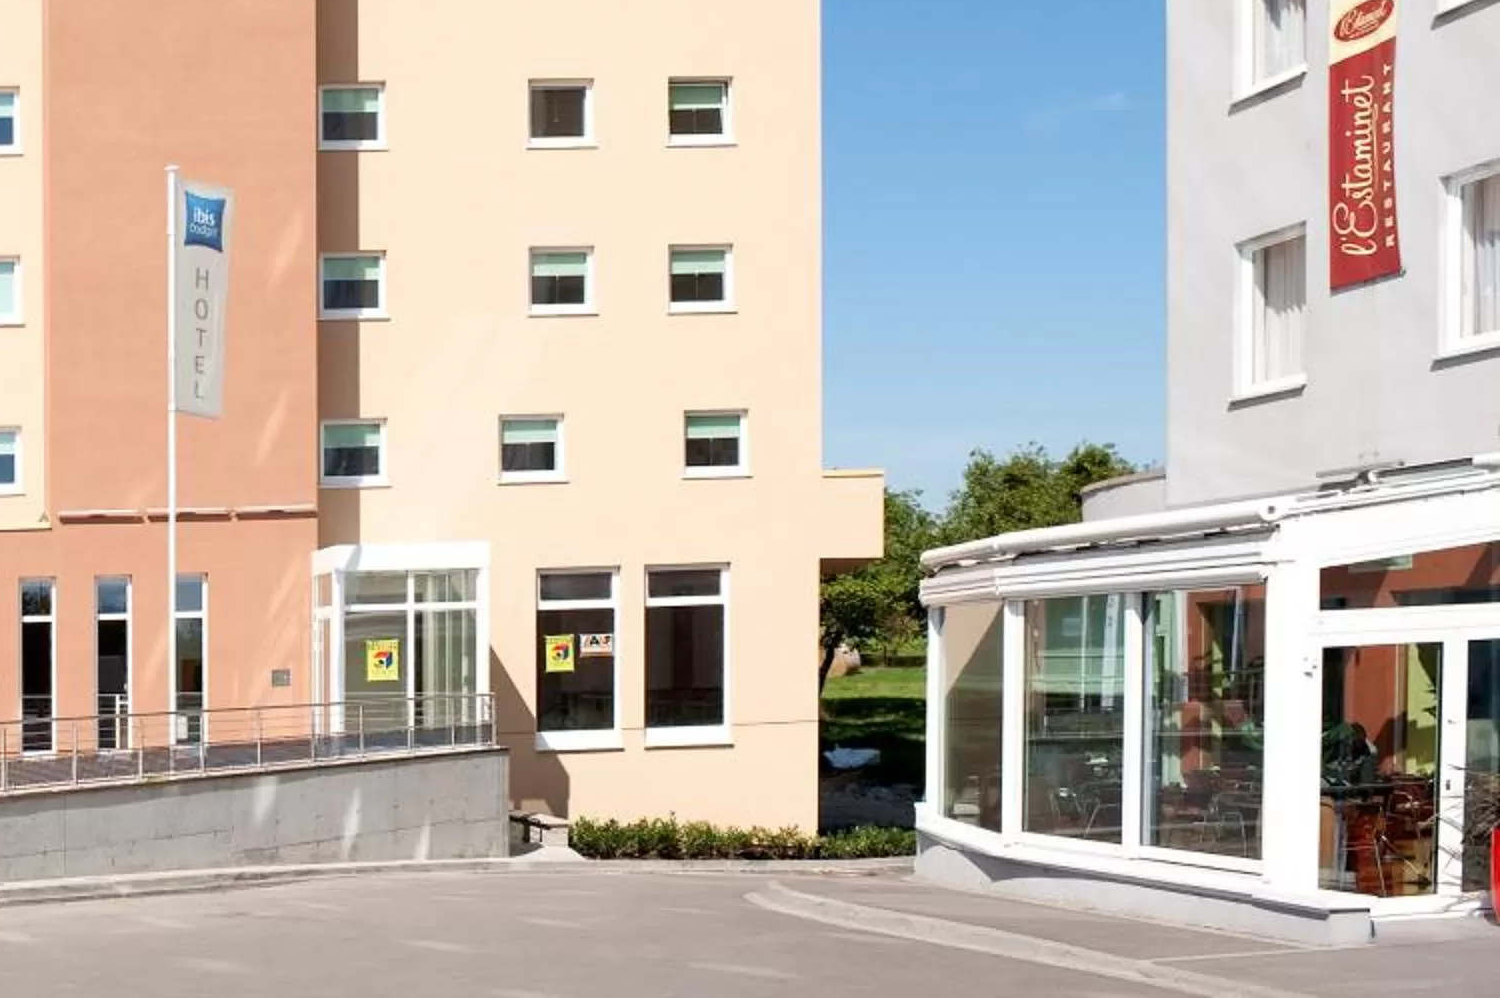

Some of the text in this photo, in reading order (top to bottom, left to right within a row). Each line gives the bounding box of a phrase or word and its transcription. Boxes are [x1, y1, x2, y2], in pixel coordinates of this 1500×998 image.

[193, 206, 215, 227] ibis
[1332, 75, 1379, 256] l'Estaminet
[194, 268, 210, 400] HOTEL
